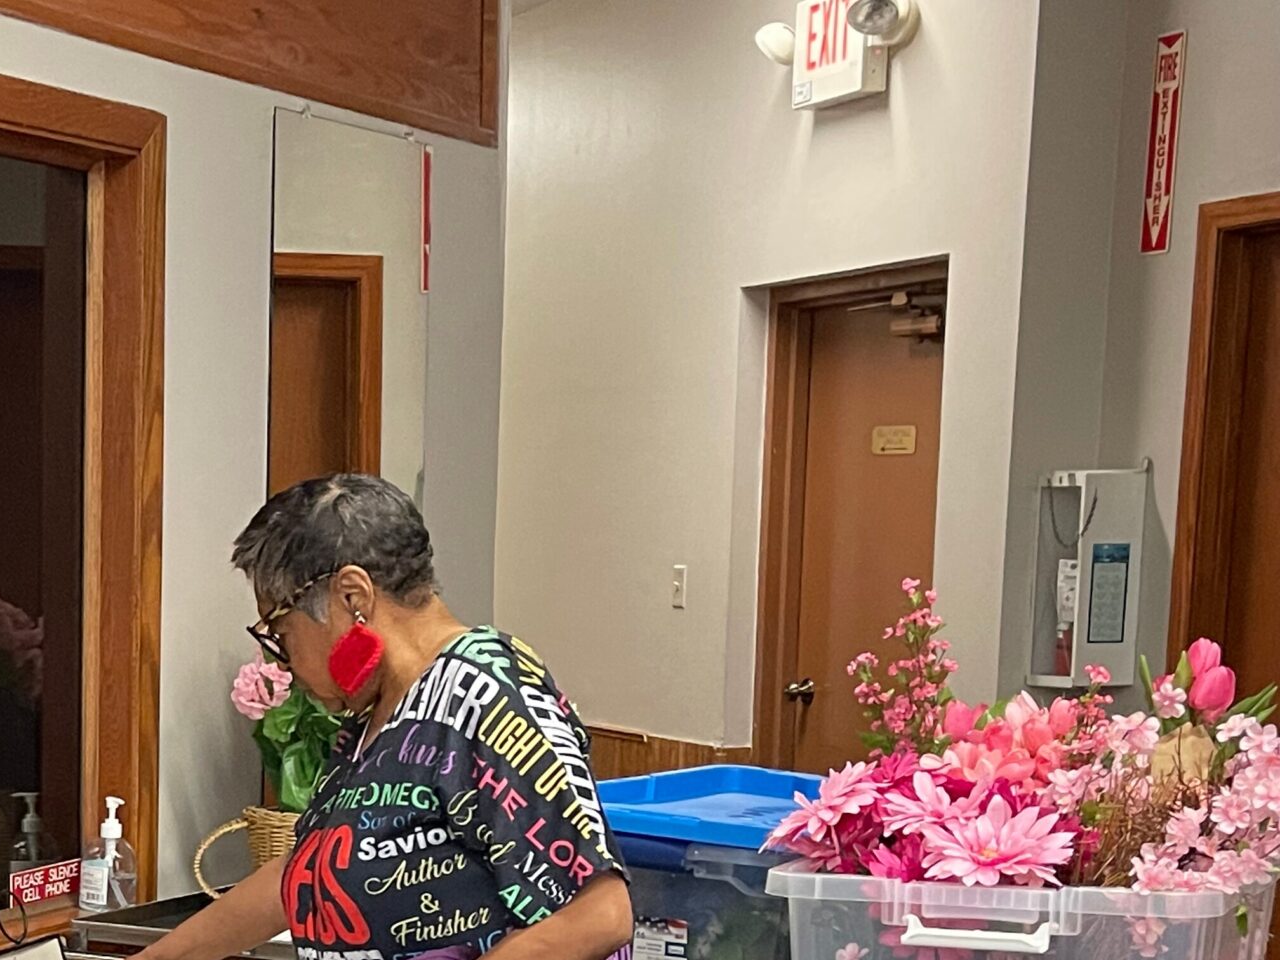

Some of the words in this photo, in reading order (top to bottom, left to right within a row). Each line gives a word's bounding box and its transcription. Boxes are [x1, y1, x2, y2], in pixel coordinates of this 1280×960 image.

[806, 0, 848, 70] EXIT
[1152, 87, 1171, 227] EXTINGUISHER
[478, 695, 552, 776] LIGHT
[364, 853, 468, 895] Author
[525, 817, 594, 886] LOR
[14, 872, 44, 891] PLEASE
[48, 862, 79, 883] SILENCE
[22, 885, 41, 903] CELL
[45, 879, 71, 897] PHONE
[514, 851, 578, 905] Messi
[391, 906, 492, 946] Finisher
[420, 892, 440, 914] &
